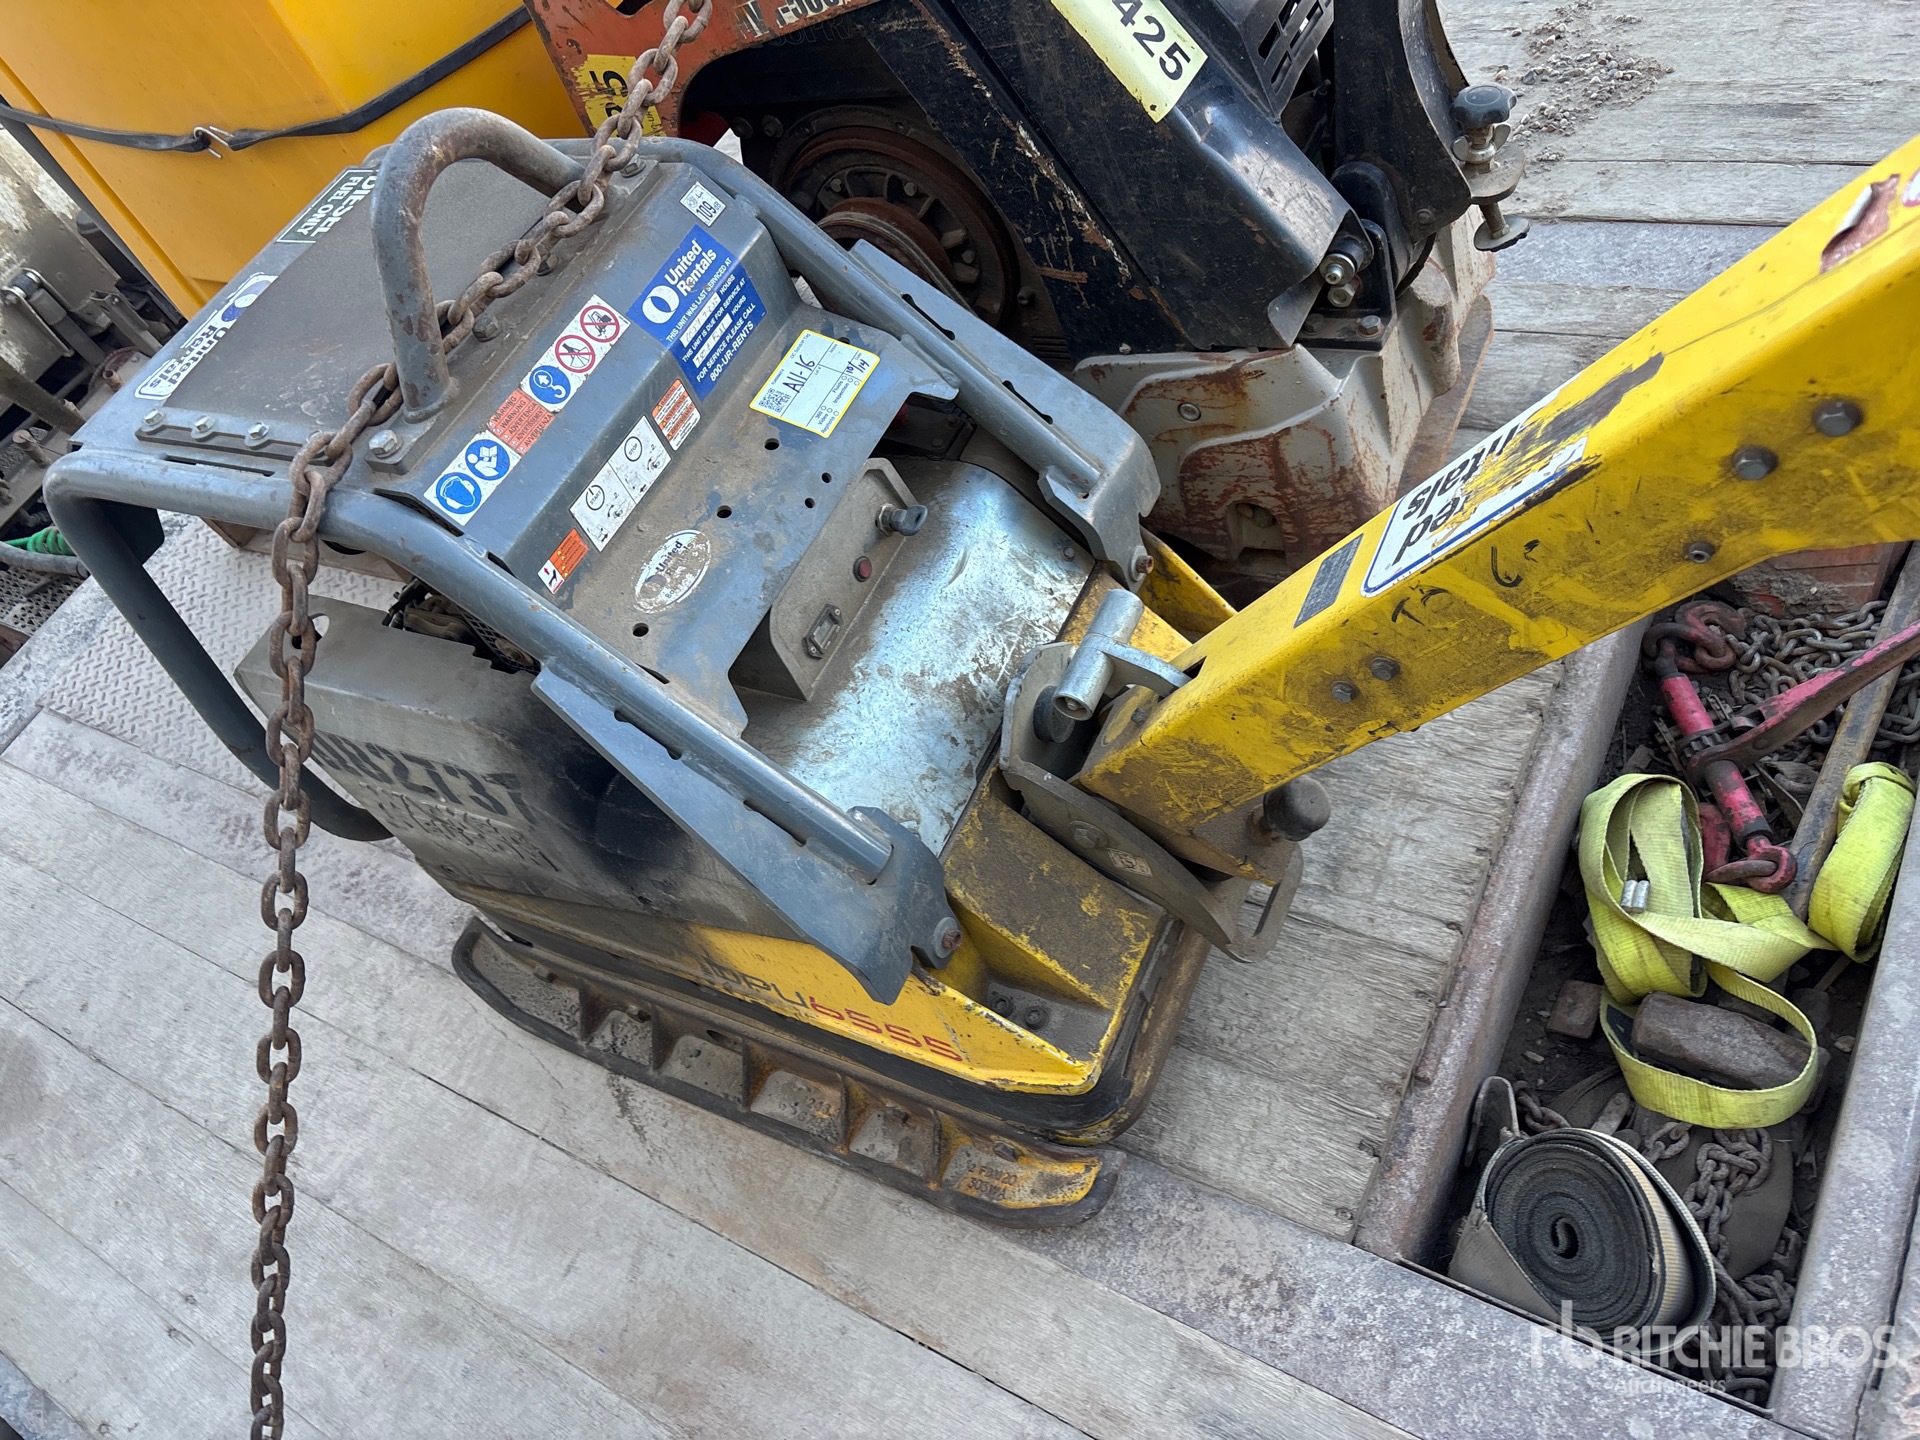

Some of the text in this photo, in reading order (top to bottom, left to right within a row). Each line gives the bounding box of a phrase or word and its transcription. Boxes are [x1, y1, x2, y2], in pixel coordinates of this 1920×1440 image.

[1112, 0, 1191, 80] 425
[297, 176, 364, 236] FUEL ONLY
[695, 200, 716, 221] 109
[664, 239, 703, 286] United
[677, 249, 717, 295] Rentals
[666, 257, 732, 342] THIS UNIT WAS LAST SERVICED AT
[718, 273, 736, 294] HOURS
[681, 277, 746, 362] THIS UNIT IS DUE FOR SERVICE AT
[730, 294, 747, 315] HOURS
[149, 325, 218, 389] Rentals
[167, 327, 228, 386] United
[695, 366, 708, 382] FOR
[705, 340, 727, 368] SERVICE
[724, 317, 745, 342] PLEASE
[741, 302, 756, 319] CALL
[708, 319, 755, 381] 800-UR-RENTS
[492, 395, 517, 423] WARNING
[832, 382, 850, 404] Inspection
[500, 399, 526, 429] WARNUNG
[507, 400, 537, 434] ADVERTENCIA
[523, 413, 553, 447] AVVERTENZA
[628, 442, 639, 455] STOP
[589, 489, 602, 505] START
[654, 538, 683, 574] United
